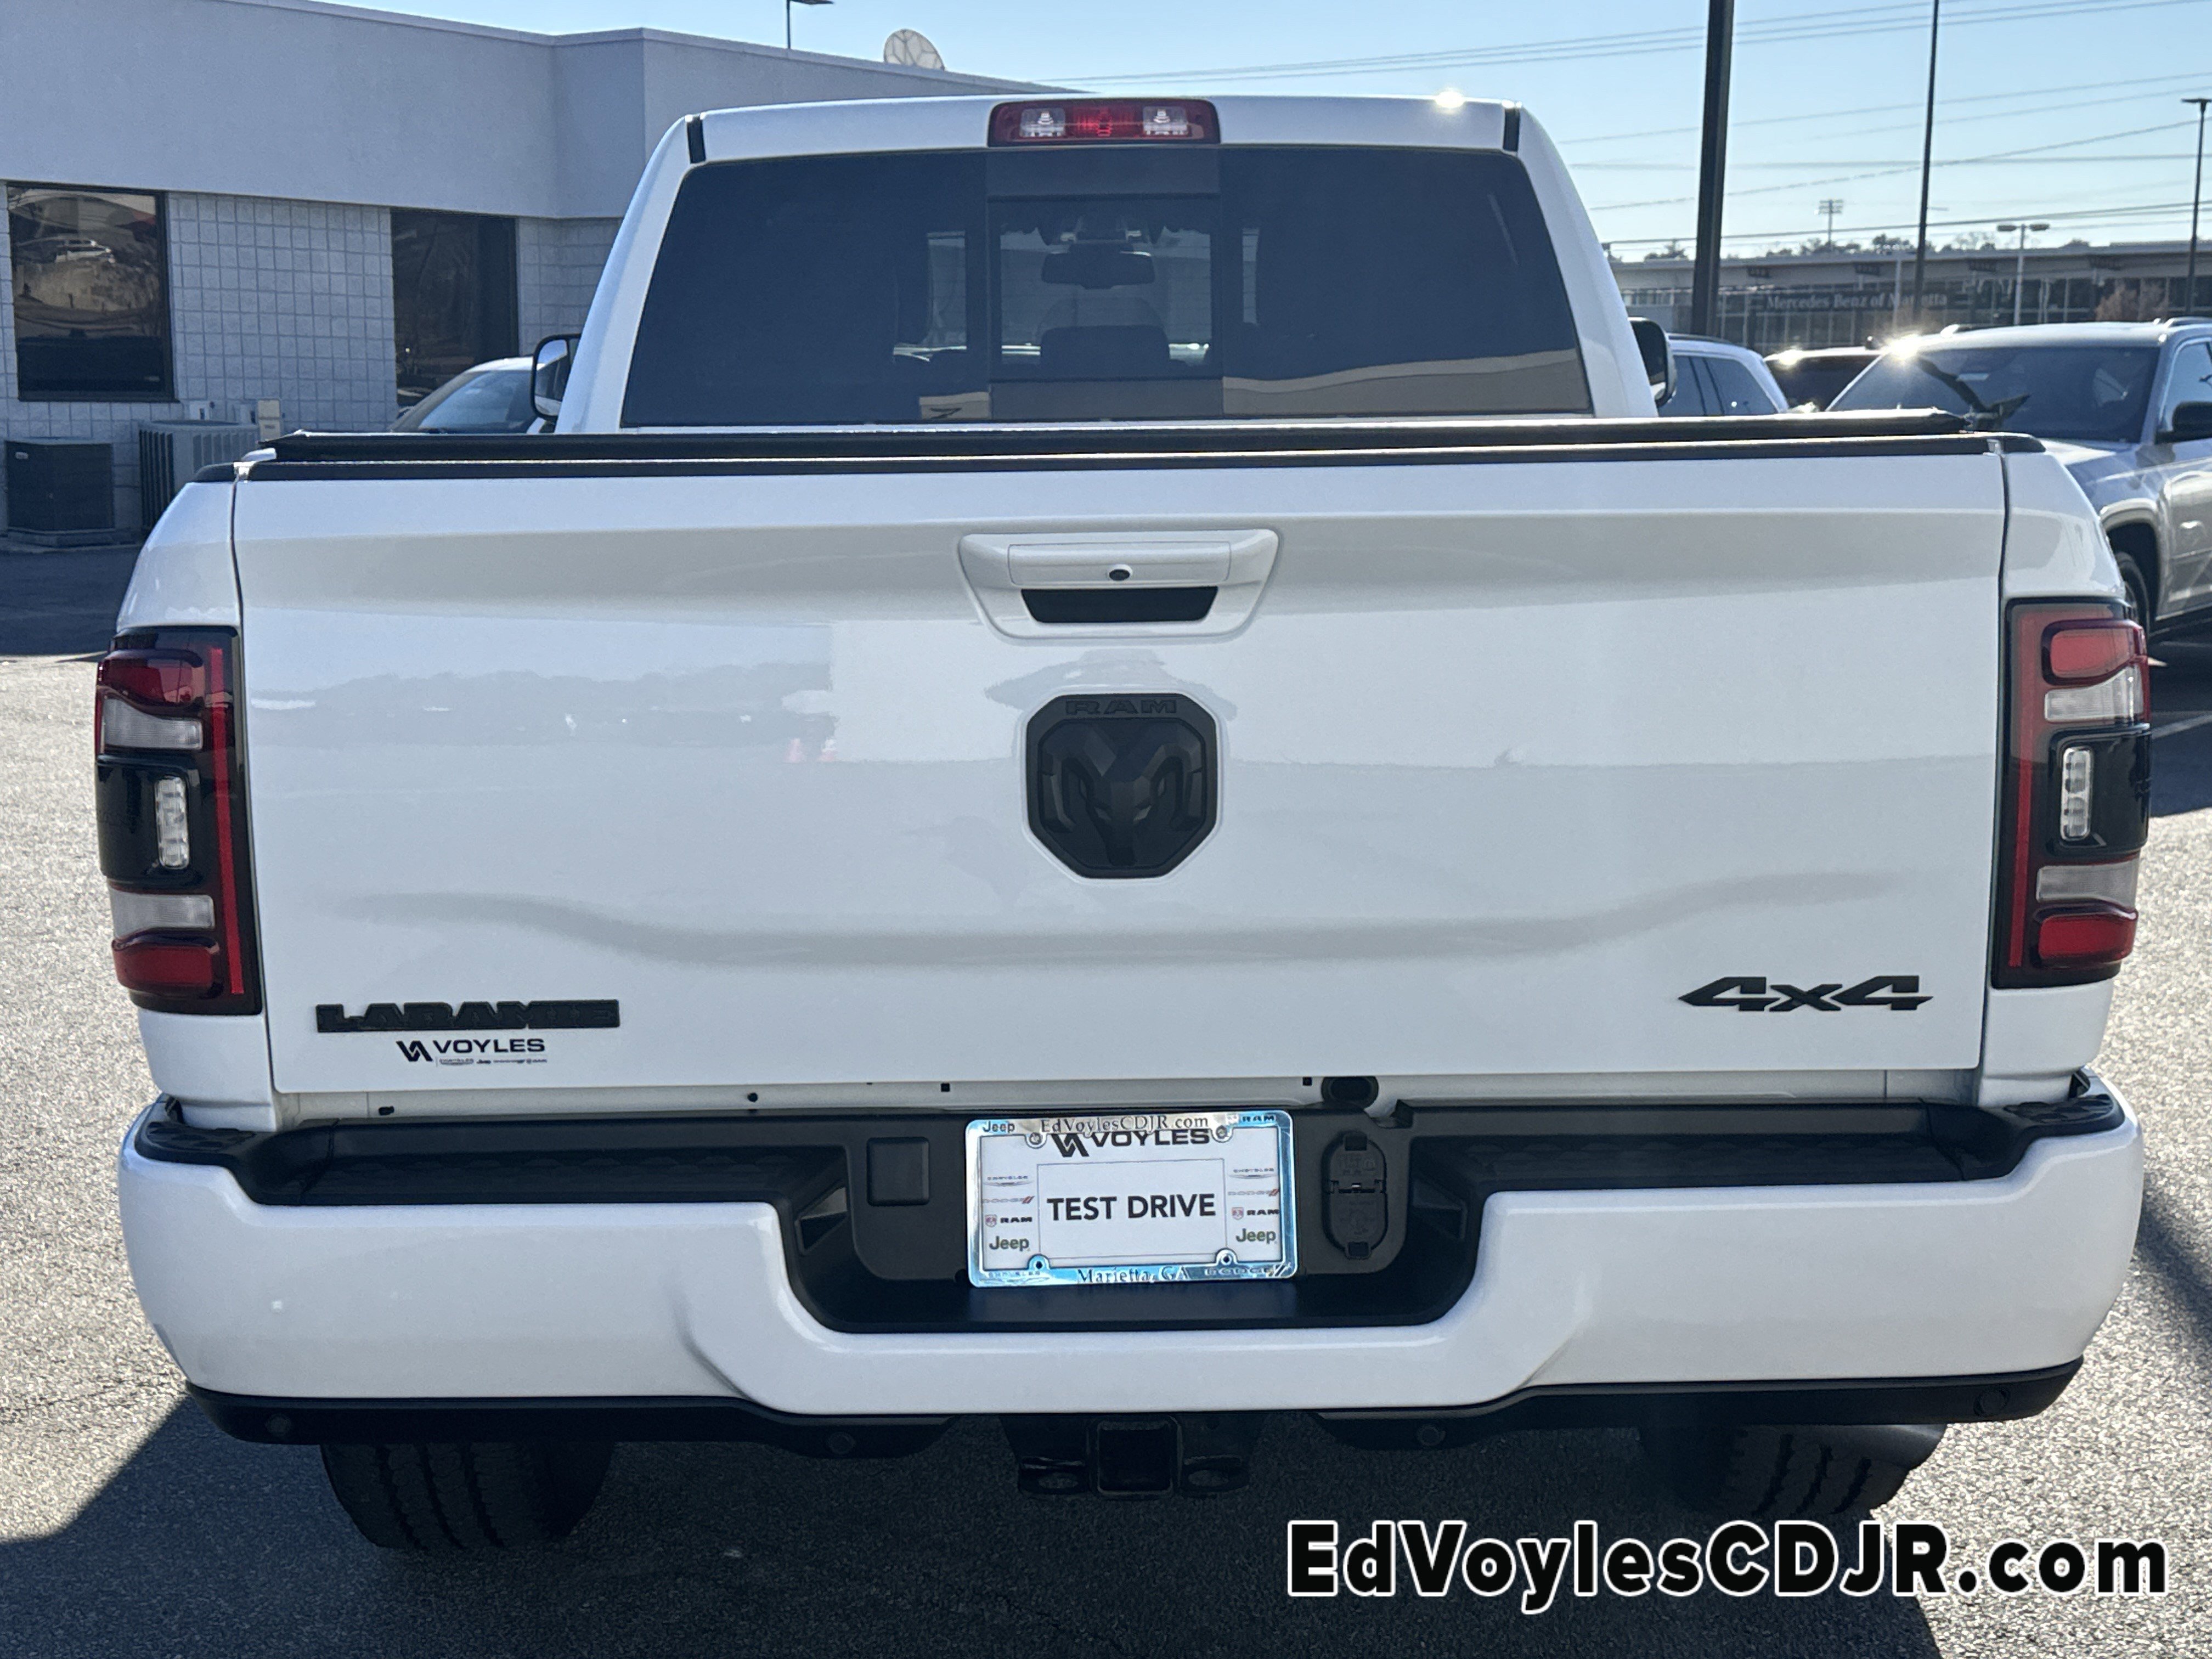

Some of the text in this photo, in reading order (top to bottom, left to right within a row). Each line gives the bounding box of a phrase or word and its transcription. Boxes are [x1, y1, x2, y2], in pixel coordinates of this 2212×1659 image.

[1065, 699, 1177, 714] RAM
[1678, 976, 1933, 1012] 4x4
[432, 1039, 545, 1053] VOYLES
[983, 1120, 1015, 1133] Jeep
[1041, 1115, 1209, 1137] EdVoylesCDJR.com
[1091, 1128, 1210, 1147] VOYLES
[1047, 1193, 1216, 1221] TEST DRIVE
[989, 1235, 1030, 1252] Jeep
[1235, 1228, 1277, 1245] Jeep
[1159, 1265, 1192, 1281] GA
